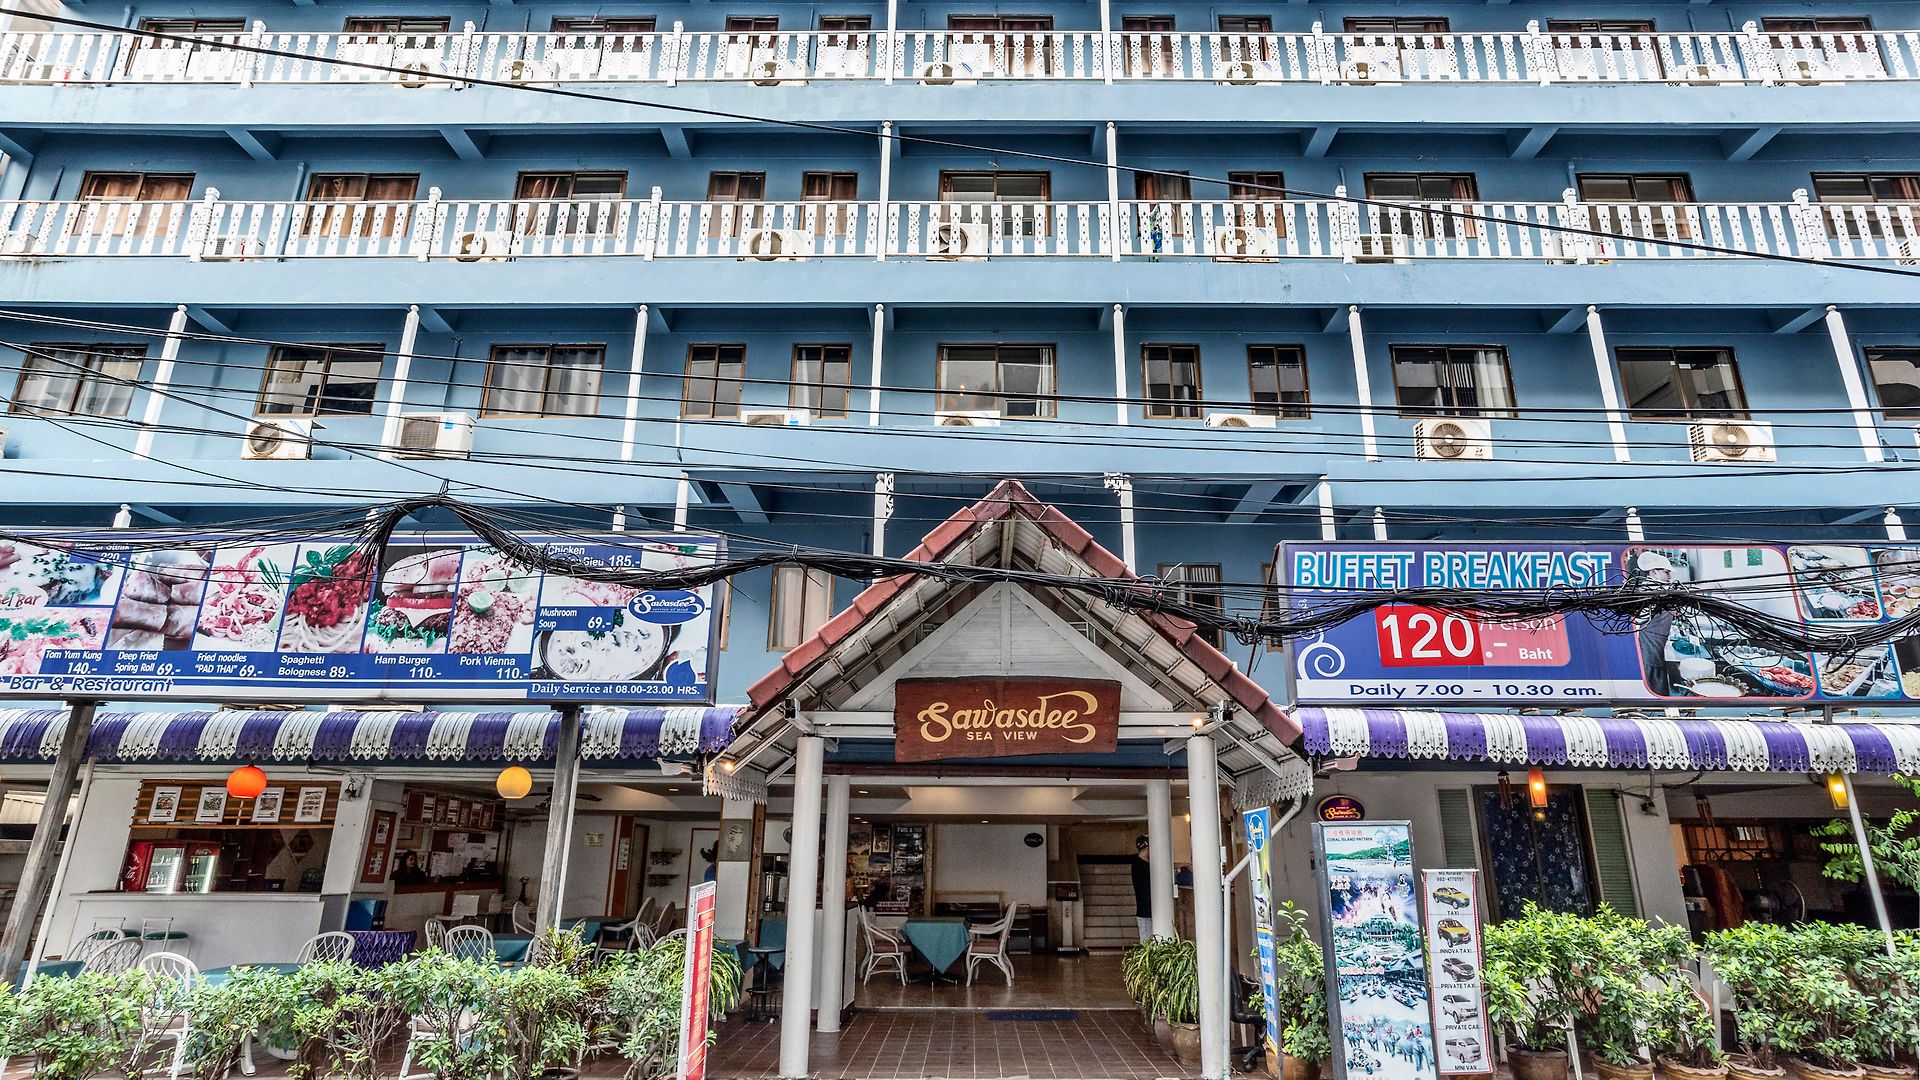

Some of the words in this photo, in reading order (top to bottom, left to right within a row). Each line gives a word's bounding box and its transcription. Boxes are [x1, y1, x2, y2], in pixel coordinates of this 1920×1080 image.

[548, 546, 585, 555] Chicken
[609, 554, 641, 568] 185.-
[1294, 551, 1415, 591] BUFFET
[1423, 551, 1612, 590] BREAKFAST
[15, 594, 42, 608] Bar
[633, 594, 703, 615] Sawasdee
[540, 608, 577, 617] Mushroom
[538, 620, 557, 630] Soup
[587, 616, 611, 629] 69.-
[46, 651, 62, 660] Tom
[64, 651, 80, 660] Yum
[82, 651, 102, 661] Kung
[118, 651, 138, 661] Deep
[140, 651, 159, 661] Fried
[197, 652, 216, 662] Fried
[218, 653, 247, 663] noodles
[1519, 647, 1553, 660] Baht
[280, 655, 325, 666] Spaghetti
[375, 655, 396, 665] Ham
[398, 655, 431, 667] Burger
[460, 656, 481, 666] Pork
[483, 656, 516, 666] Vienna
[67, 662, 97, 675] 140.-
[114, 662, 138, 674] Spring
[140, 662, 155, 672] Roll
[157, 663, 181, 676] 69.-
[239, 665, 263, 677] 69.-
[278, 667, 326, 678] Bolognese
[329, 666, 355, 679] 89.-
[409, 667, 442, 679] 110.-
[496, 667, 528, 680] 110.-
[9, 676, 43, 690] Bar
[50, 677, 64, 691] &
[72, 677, 174, 692] Restaurant
[532, 683, 560, 696] Daily
[562, 684, 601, 694] Service
[603, 685, 613, 694] at
[615, 685, 673, 695] 08.00-23.00
[677, 686, 700, 695] HRS.
[1350, 683, 1406, 699] Daily
[1415, 684, 1464, 697] 7.00
[1495, 684, 1553, 697] 10.30
[1563, 685, 1603, 697] am.
[917, 690, 1098, 744] Sawasdee
[966, 731, 993, 741] SEA
[1003, 731, 1038, 741] VIEW
